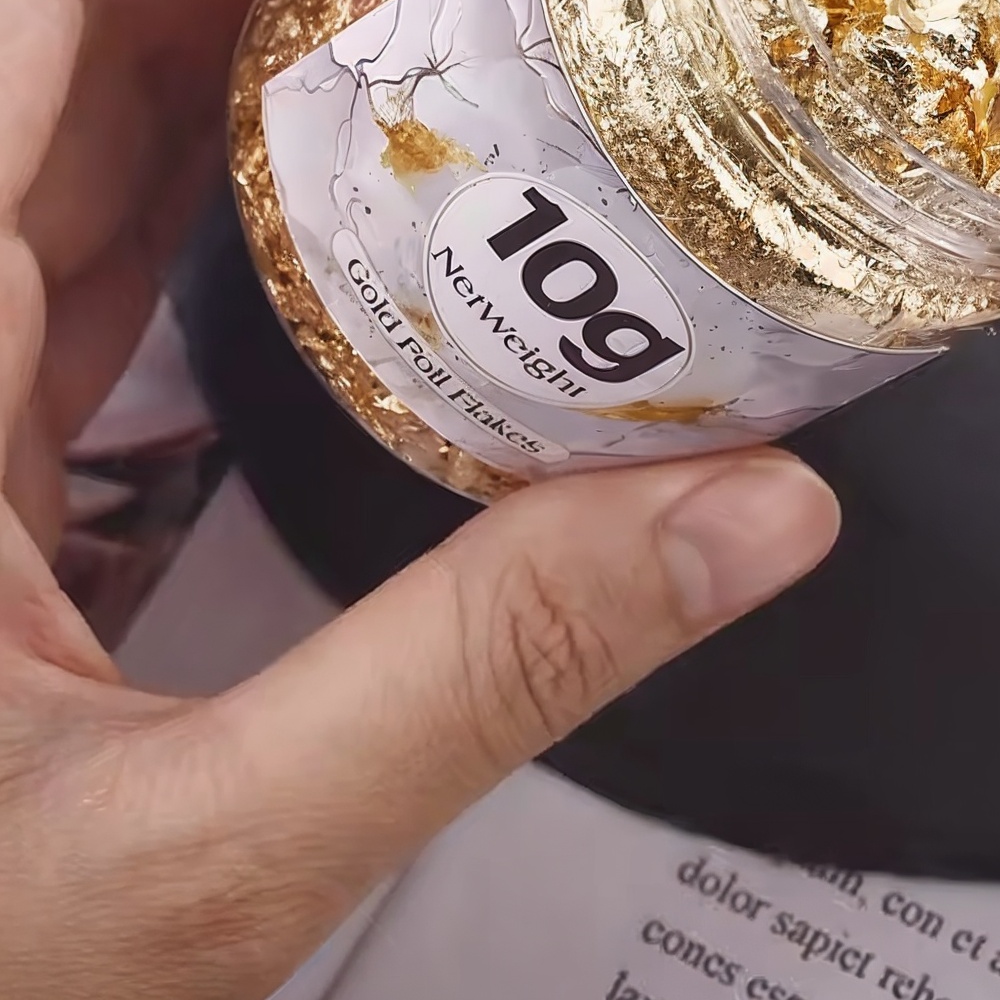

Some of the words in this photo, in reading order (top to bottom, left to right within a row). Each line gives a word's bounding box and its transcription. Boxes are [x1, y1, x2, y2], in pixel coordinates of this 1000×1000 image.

[486, 186, 687, 384] 10g
[348, 258, 403, 334] Gold
[396, 336, 453, 388] Foil
[447, 388, 547, 454] Flakes
[676, 857, 771, 921] dolor
[881, 891, 945, 939] con
